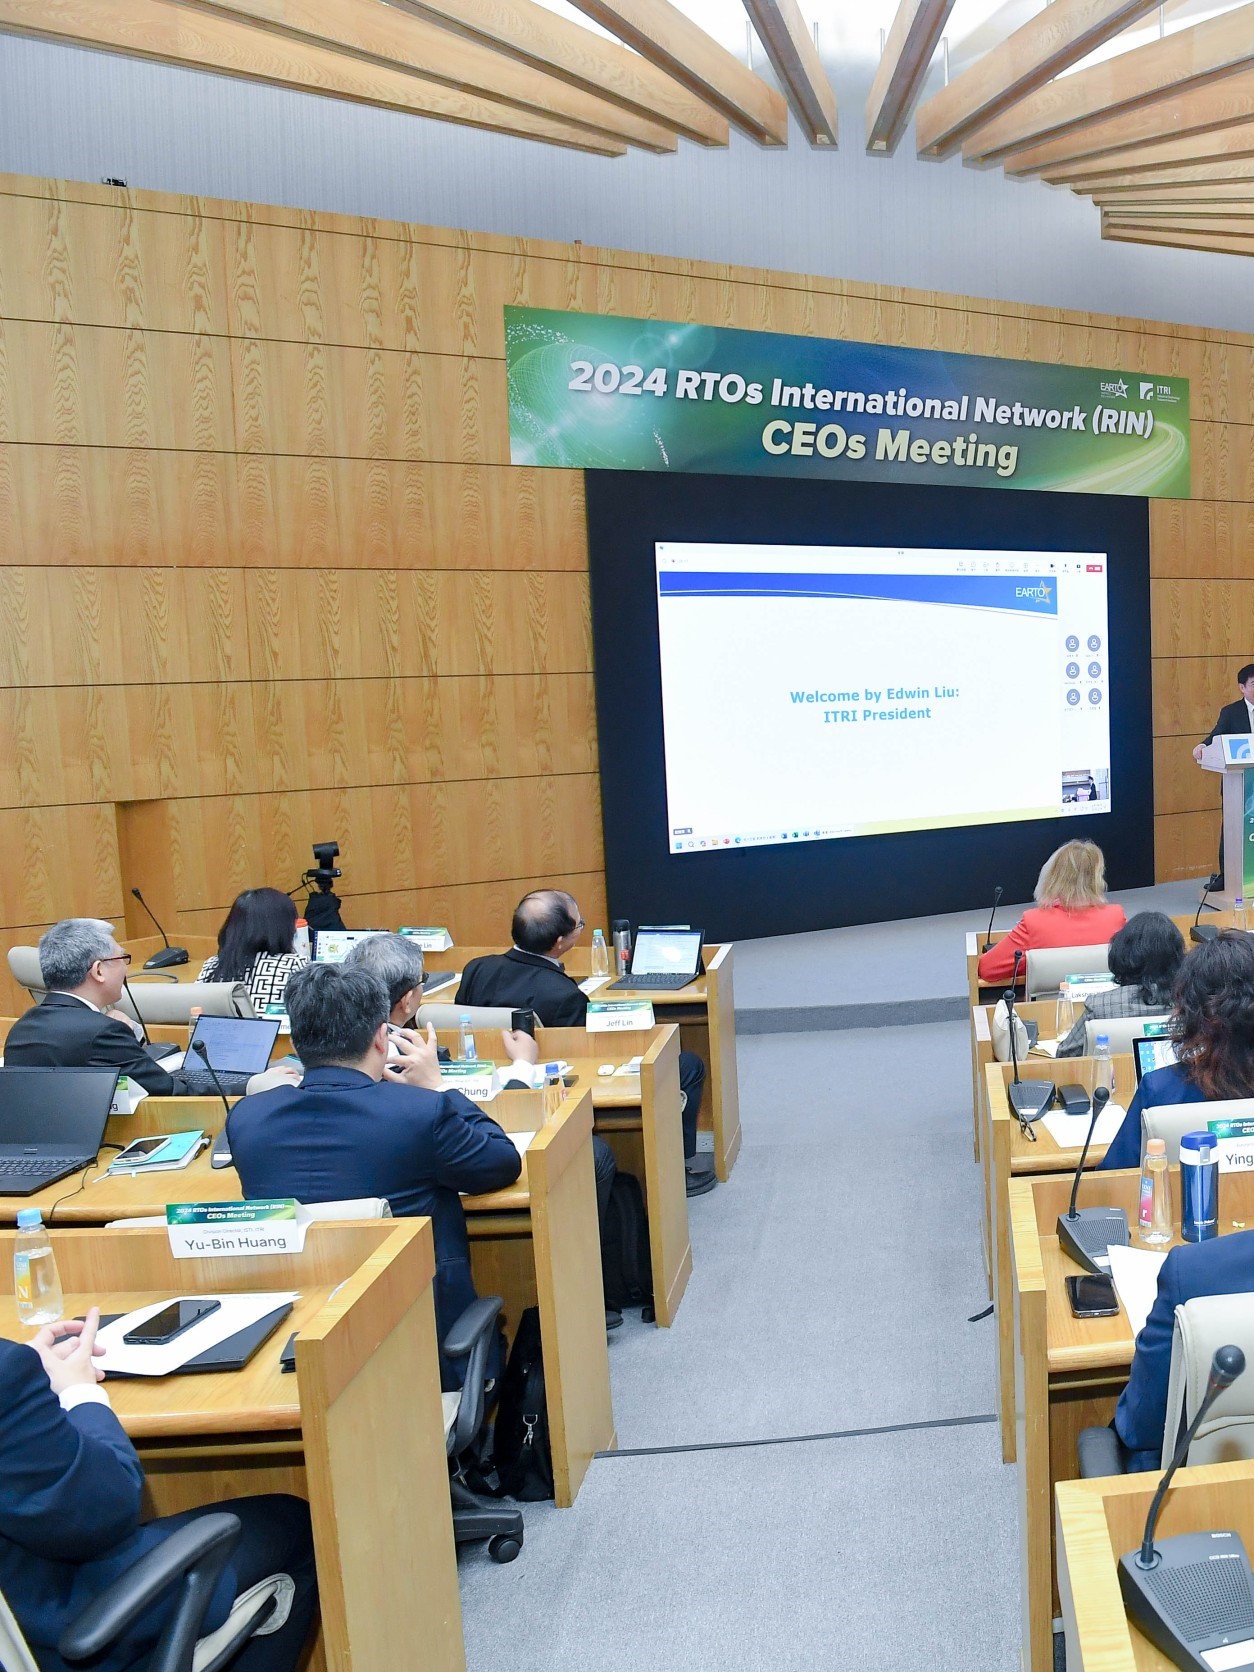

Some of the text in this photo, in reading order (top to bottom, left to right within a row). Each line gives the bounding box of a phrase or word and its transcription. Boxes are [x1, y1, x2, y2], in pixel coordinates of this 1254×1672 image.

[1157, 385, 1171, 395] ITRI
[568, 360, 1155, 440] 2024 RTOs International Network (RIN)
[761, 419, 1019, 477] CEOs Meeting
[1015, 587, 1045, 598] EARTO
[790, 686, 960, 703] Welcome by Edwin Liu:
[824, 707, 931, 723] ITRI President
[185, 1237, 287, 1251] Yu-Bin Huang
[17, 1285, 29, 1299] N
